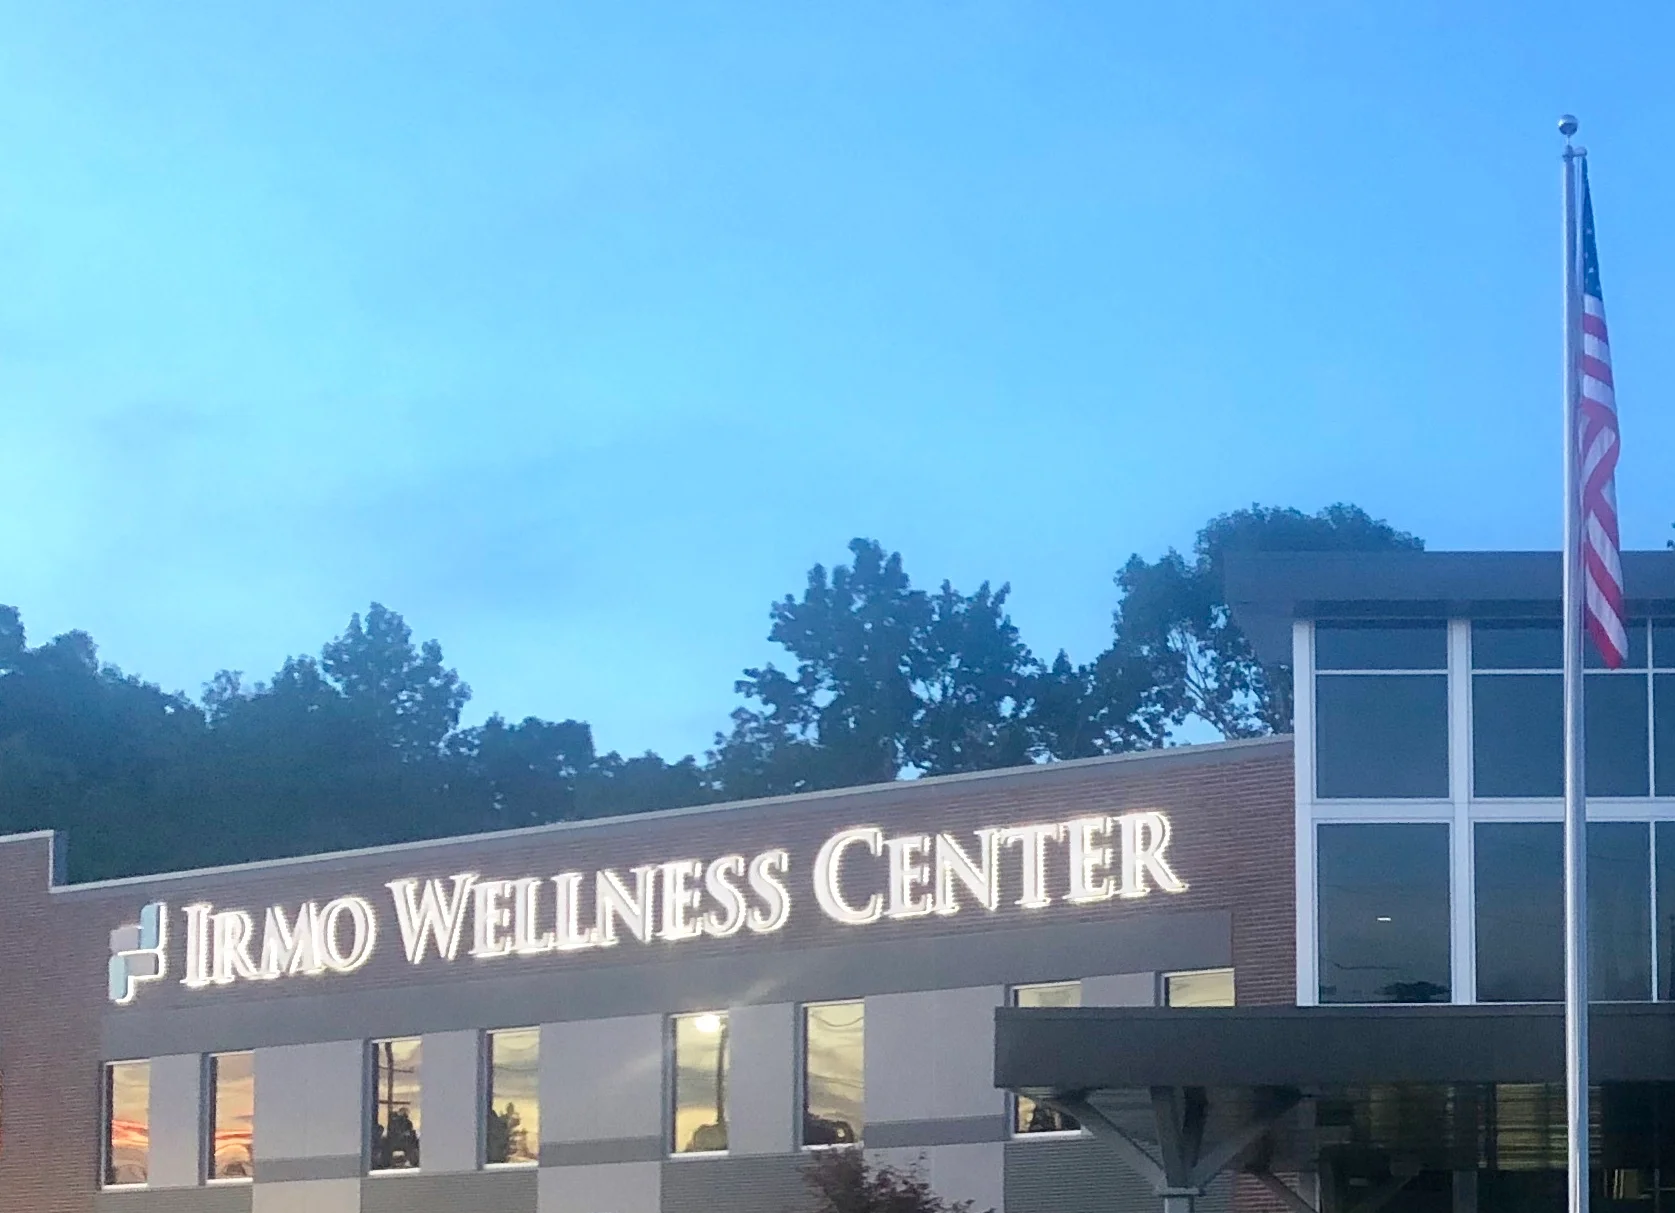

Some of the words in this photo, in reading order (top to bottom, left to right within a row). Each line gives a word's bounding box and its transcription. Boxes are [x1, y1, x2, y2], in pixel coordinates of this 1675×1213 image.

[180, 895, 377, 986] IRMO
[384, 849, 792, 964] WELLNESS
[813, 810, 1190, 925] CENTER
